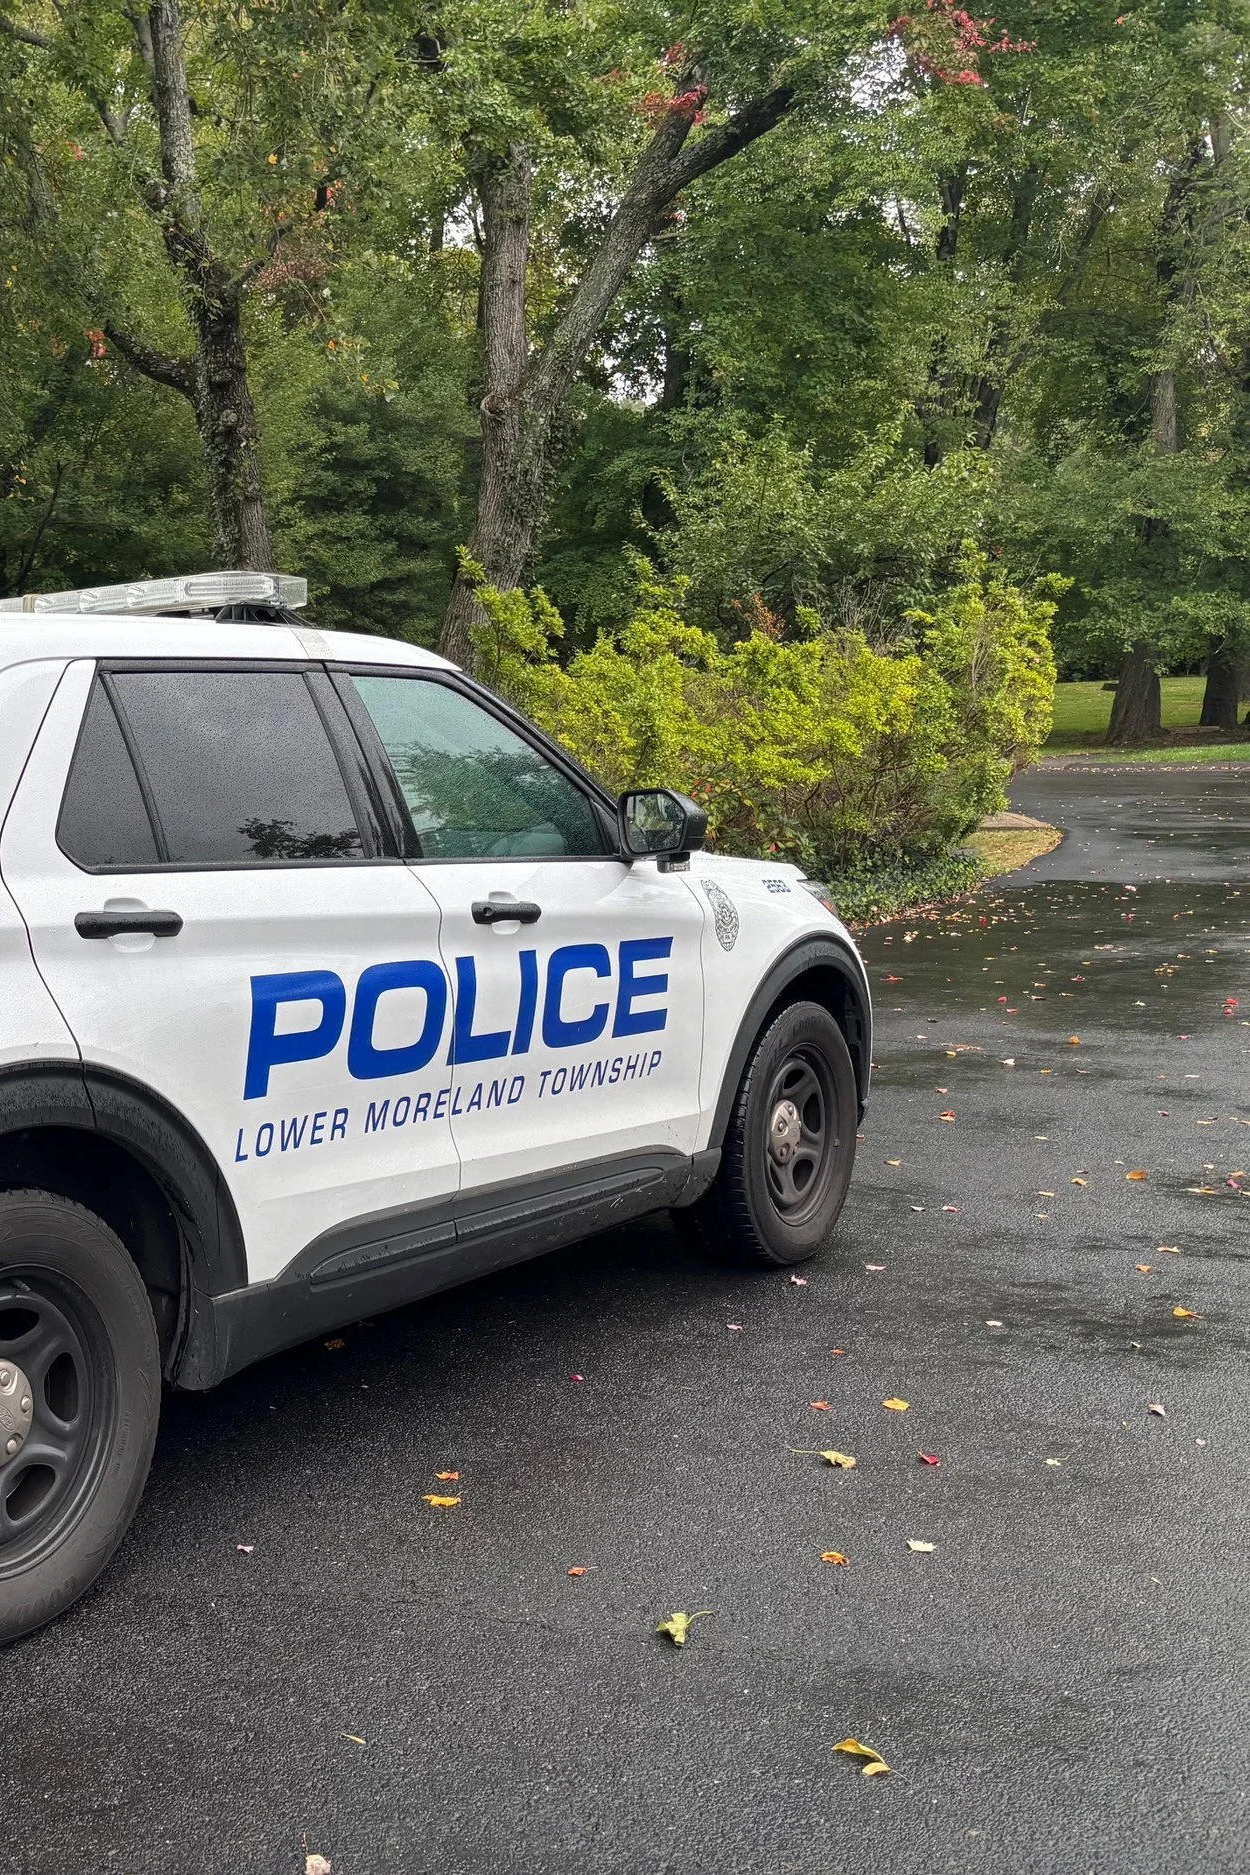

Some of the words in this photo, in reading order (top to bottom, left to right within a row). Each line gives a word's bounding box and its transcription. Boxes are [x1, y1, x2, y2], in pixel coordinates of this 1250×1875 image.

[243, 936, 674, 1101] POLICE
[233, 1107, 349, 1163] LOWER
[364, 1074, 526, 1134] MORELAND
[538, 1050, 662, 1099] TOWNSHIP
